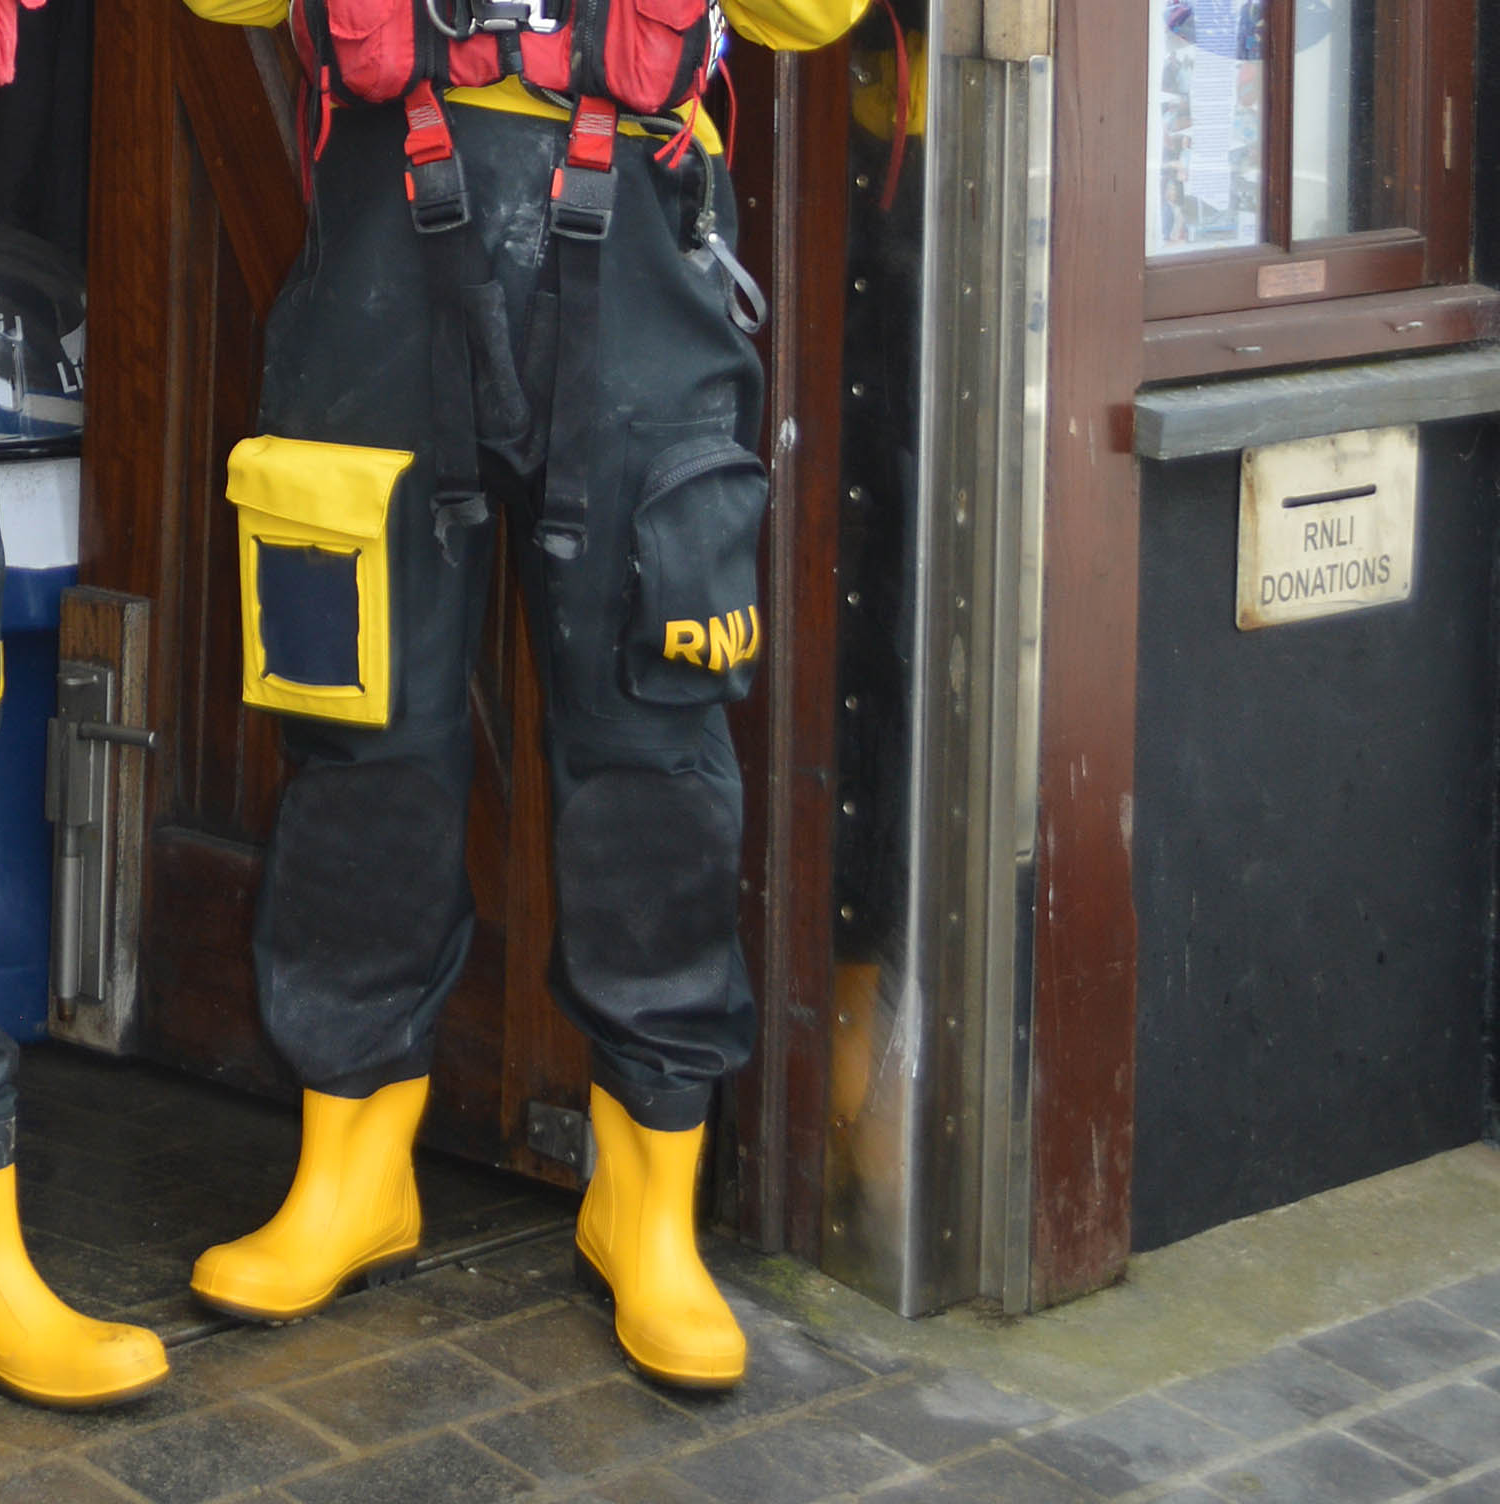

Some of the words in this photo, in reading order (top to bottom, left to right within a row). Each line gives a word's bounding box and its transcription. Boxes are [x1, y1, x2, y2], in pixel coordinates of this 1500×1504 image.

[1304, 515, 1354, 552] RNLI
[1261, 554, 1391, 605] DONATIONS
[663, 604, 758, 671] RNLI
